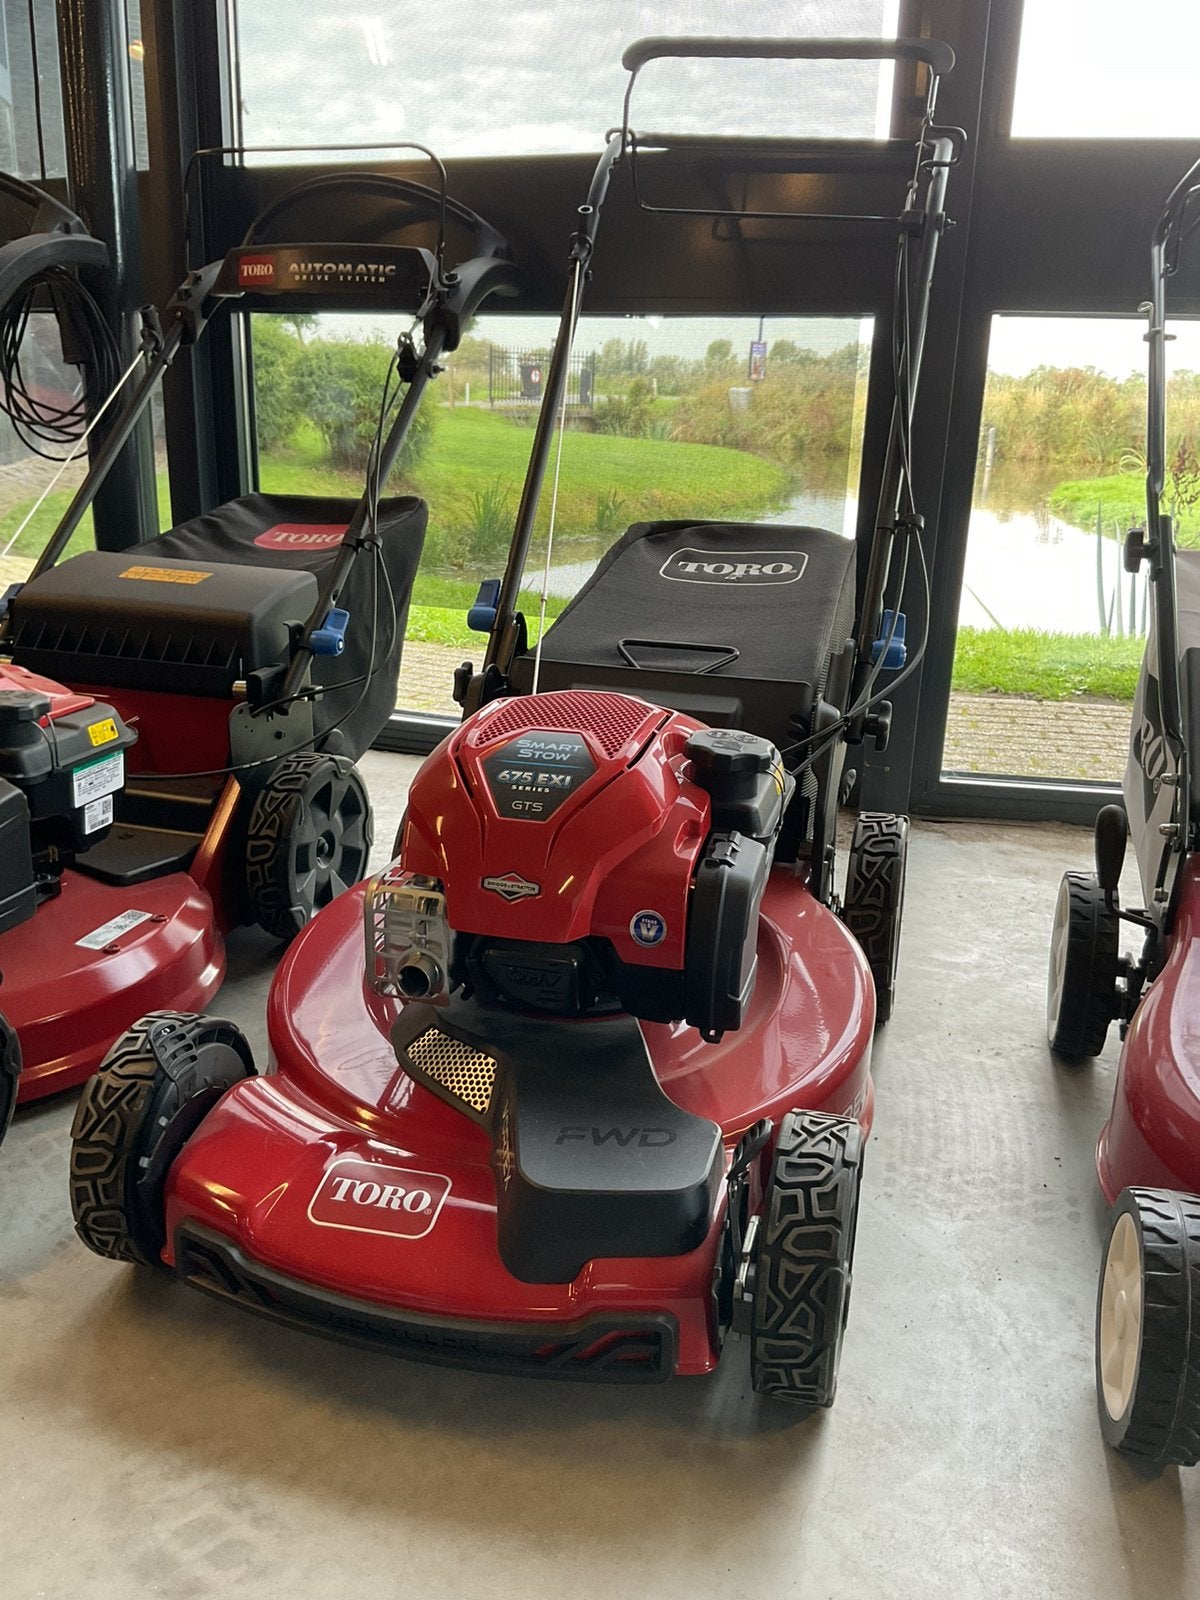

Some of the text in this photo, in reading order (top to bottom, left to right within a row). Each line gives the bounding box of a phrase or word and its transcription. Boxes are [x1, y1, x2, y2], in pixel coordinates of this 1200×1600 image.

[241, 264, 273, 277] TORO
[288, 263, 397, 276] AUTOMATIC
[339, 275, 386, 283] SYSTEM
[272, 531, 345, 544] TORO
[678, 561, 794, 576] TORO
[516, 739, 583, 752] SMART
[517, 748, 571, 761] STOW
[498, 769, 572, 787] 675 EXI
[511, 784, 550, 793] SERIES
[511, 800, 544, 812] GTS
[554, 1126, 678, 1147] FWD
[330, 1177, 432, 1213] TORO
